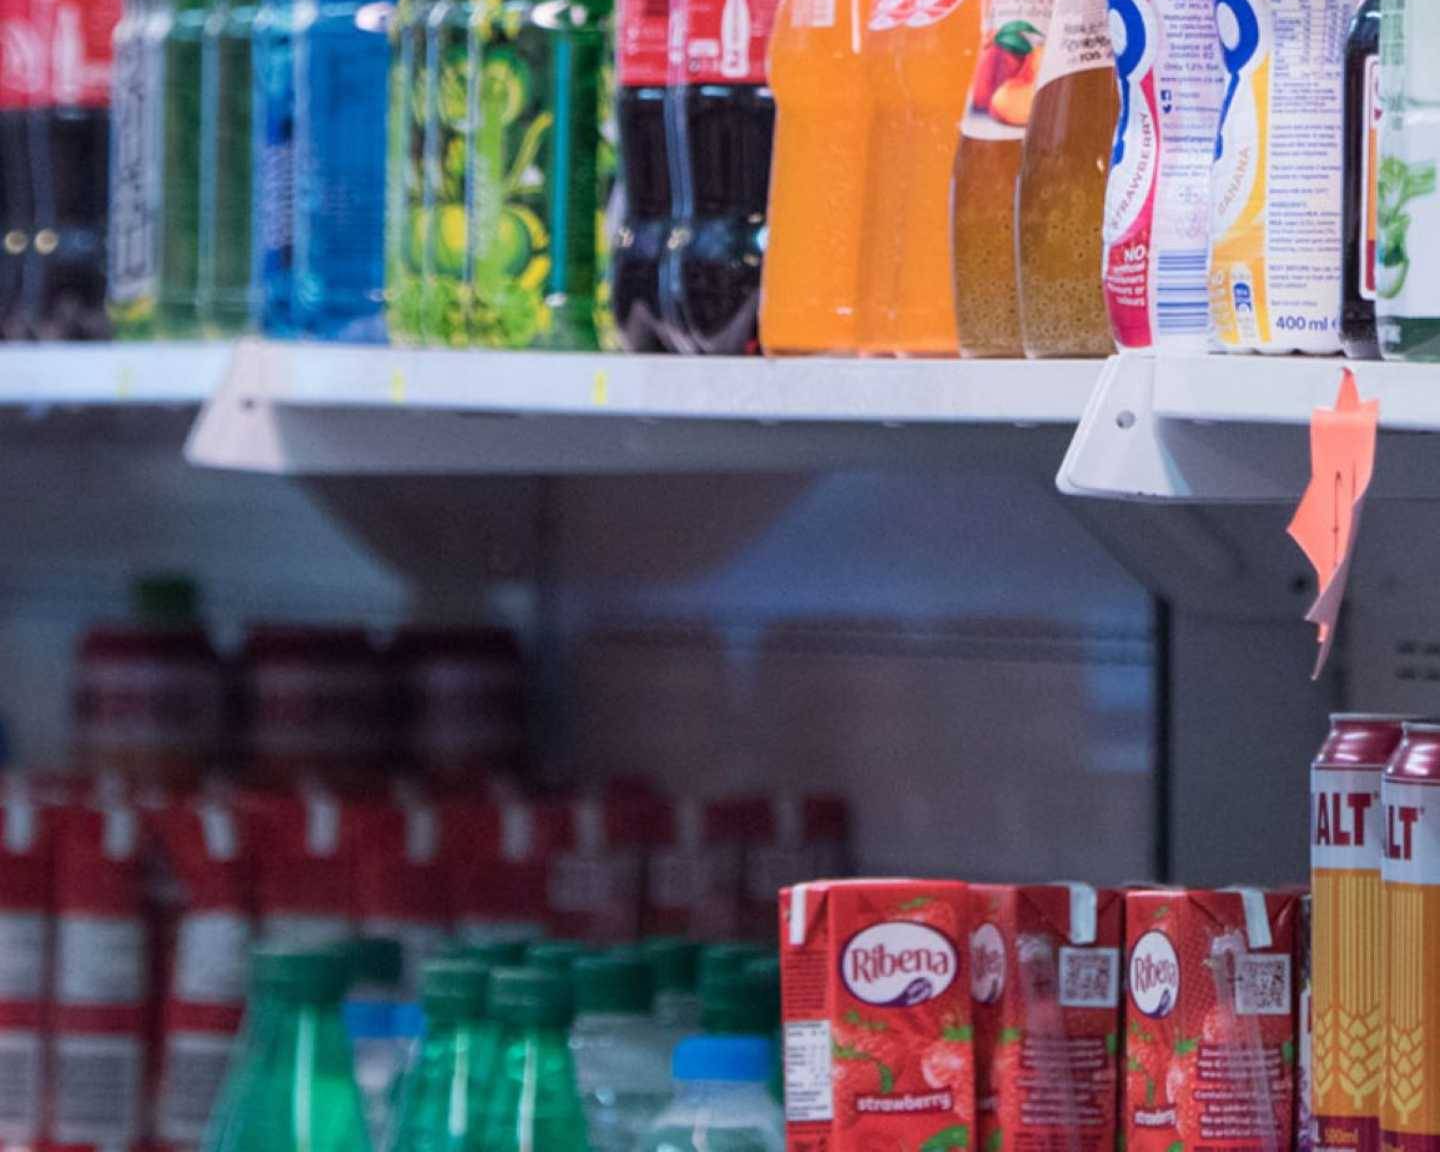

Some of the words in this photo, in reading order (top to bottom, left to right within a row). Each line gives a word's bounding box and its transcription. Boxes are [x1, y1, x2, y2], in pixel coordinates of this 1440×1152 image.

[1276, 316, 1306, 329] 400
[853, 945, 949, 984] Ribena
[856, 1093, 951, 1112] strawberry
